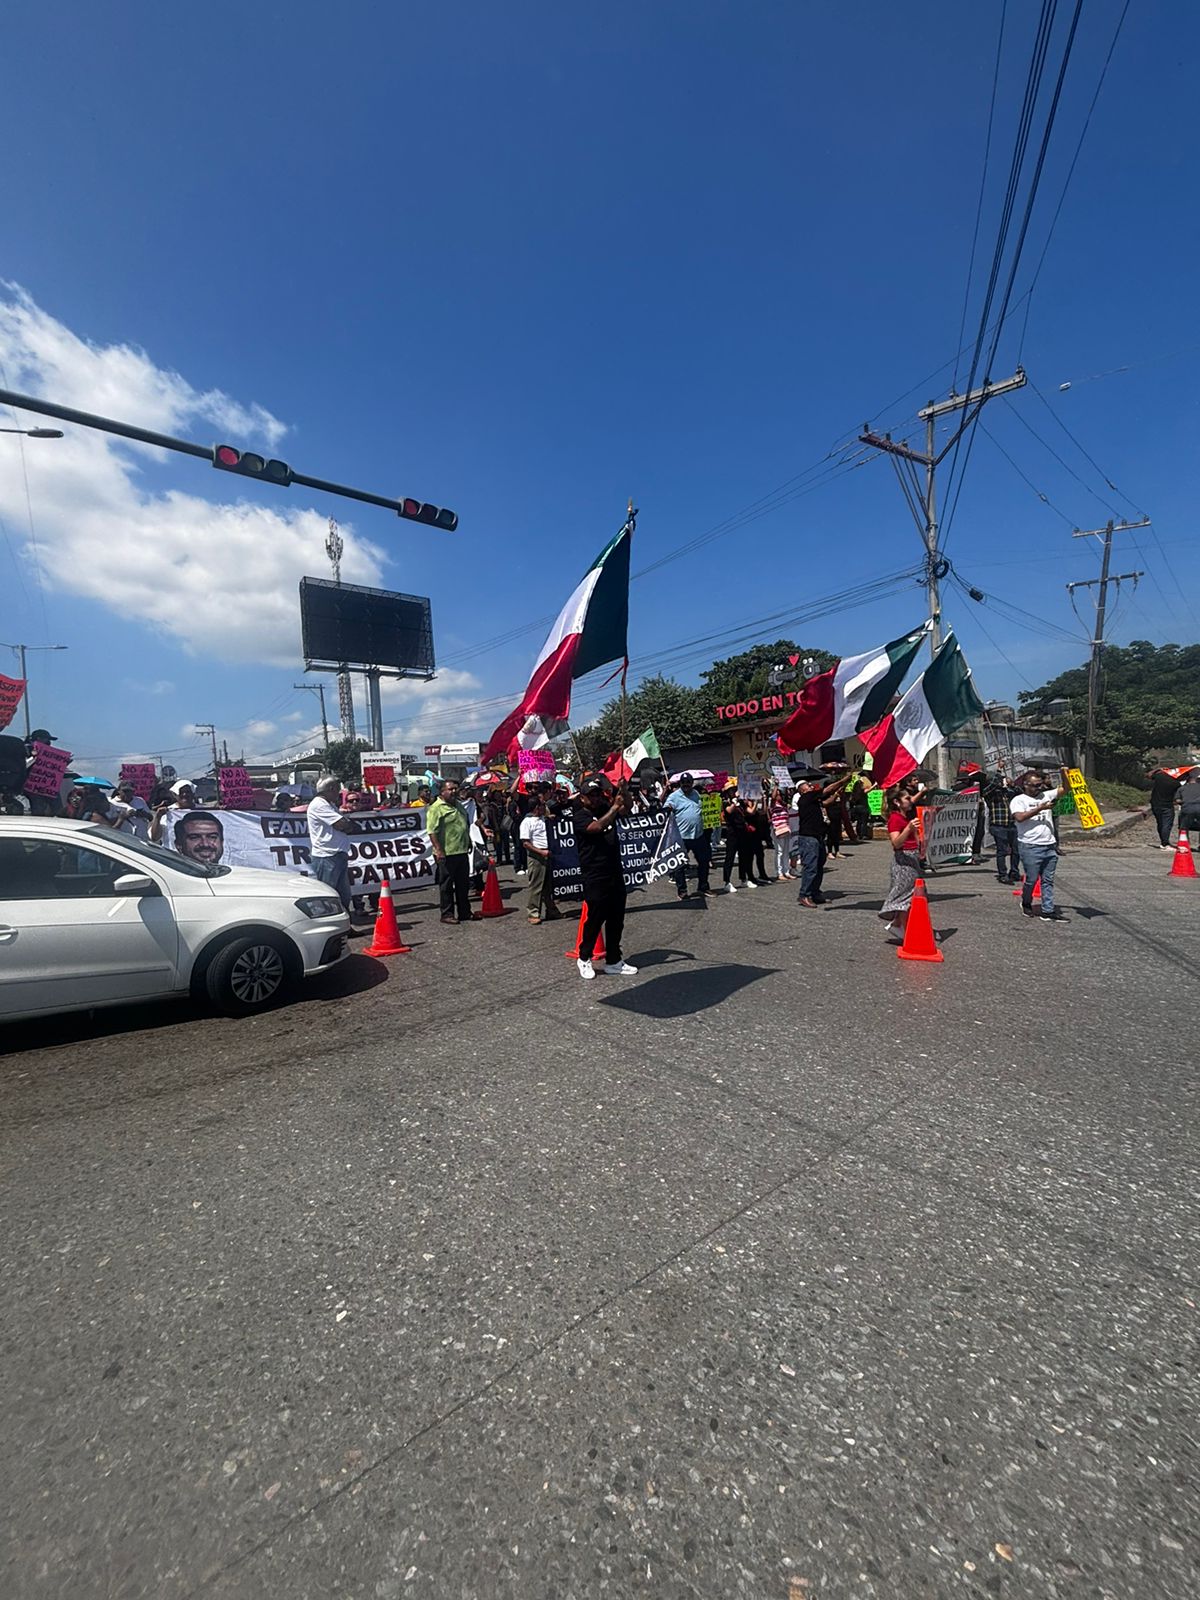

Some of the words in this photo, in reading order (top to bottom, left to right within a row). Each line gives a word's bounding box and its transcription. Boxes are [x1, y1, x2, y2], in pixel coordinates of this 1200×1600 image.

[716, 699, 759, 719] TODO
[762, 694, 784, 711] EN
[122, 764, 138, 774] NO
[363, 757, 400, 765] BIENVENIDOS
[222, 768, 234, 779] NO
[936, 808, 977, 822] CONSTITUC
[268, 820, 310, 835] FAM
[354, 816, 417, 831] YUNES
[945, 823, 976, 838] DIVISIÓ
[560, 838, 575, 848] NO
[628, 830, 645, 841] SER
[552, 867, 582, 878] DONDE
[626, 856, 661, 869] JUDICIAL
[661, 842, 681, 858] ESTA
[348, 859, 433, 886] PATRIA
[553, 883, 584, 897] SOMET
[622, 851, 688, 886] DICTADOR
